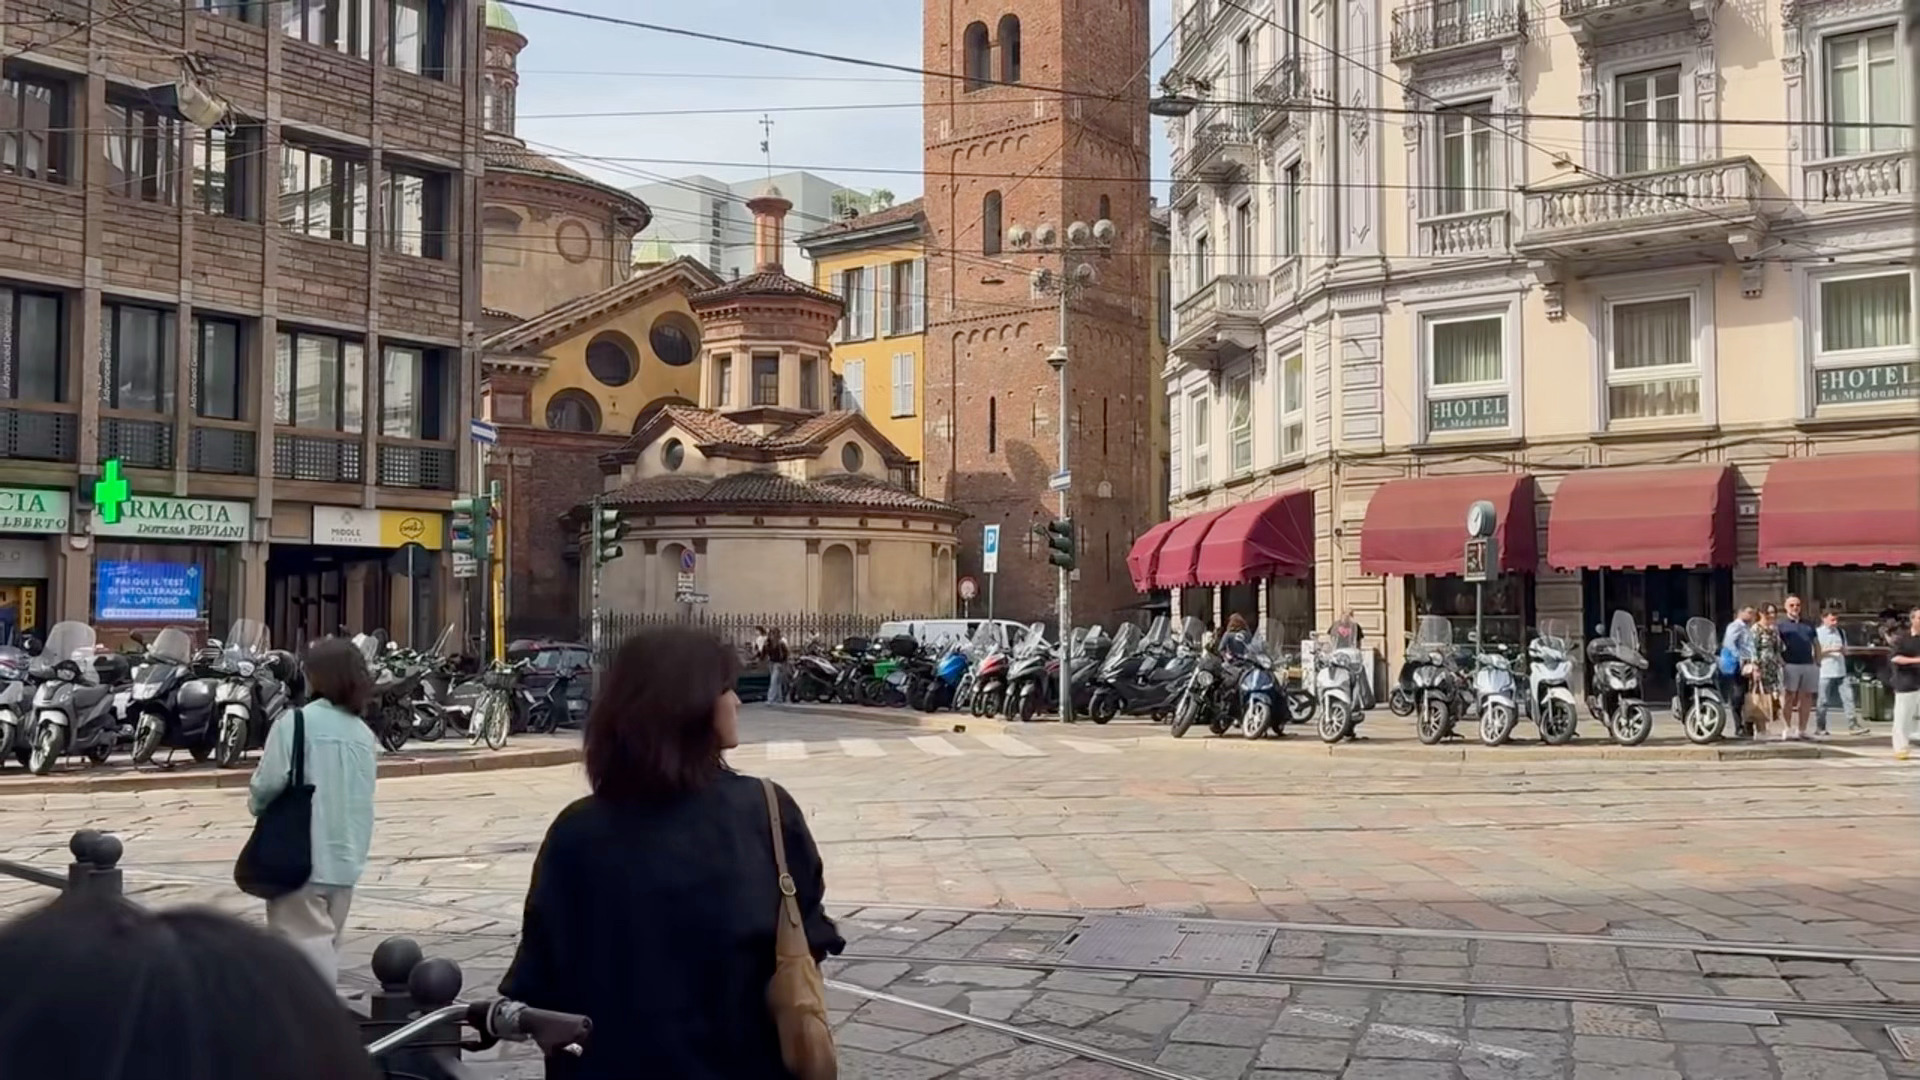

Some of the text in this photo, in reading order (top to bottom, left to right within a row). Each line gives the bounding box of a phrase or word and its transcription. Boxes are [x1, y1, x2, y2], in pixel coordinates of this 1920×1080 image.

[1440, 398, 1506, 418] HOTEL
[187, 524, 244, 538] PEVIANI
[163, 579, 184, 587] TEST
